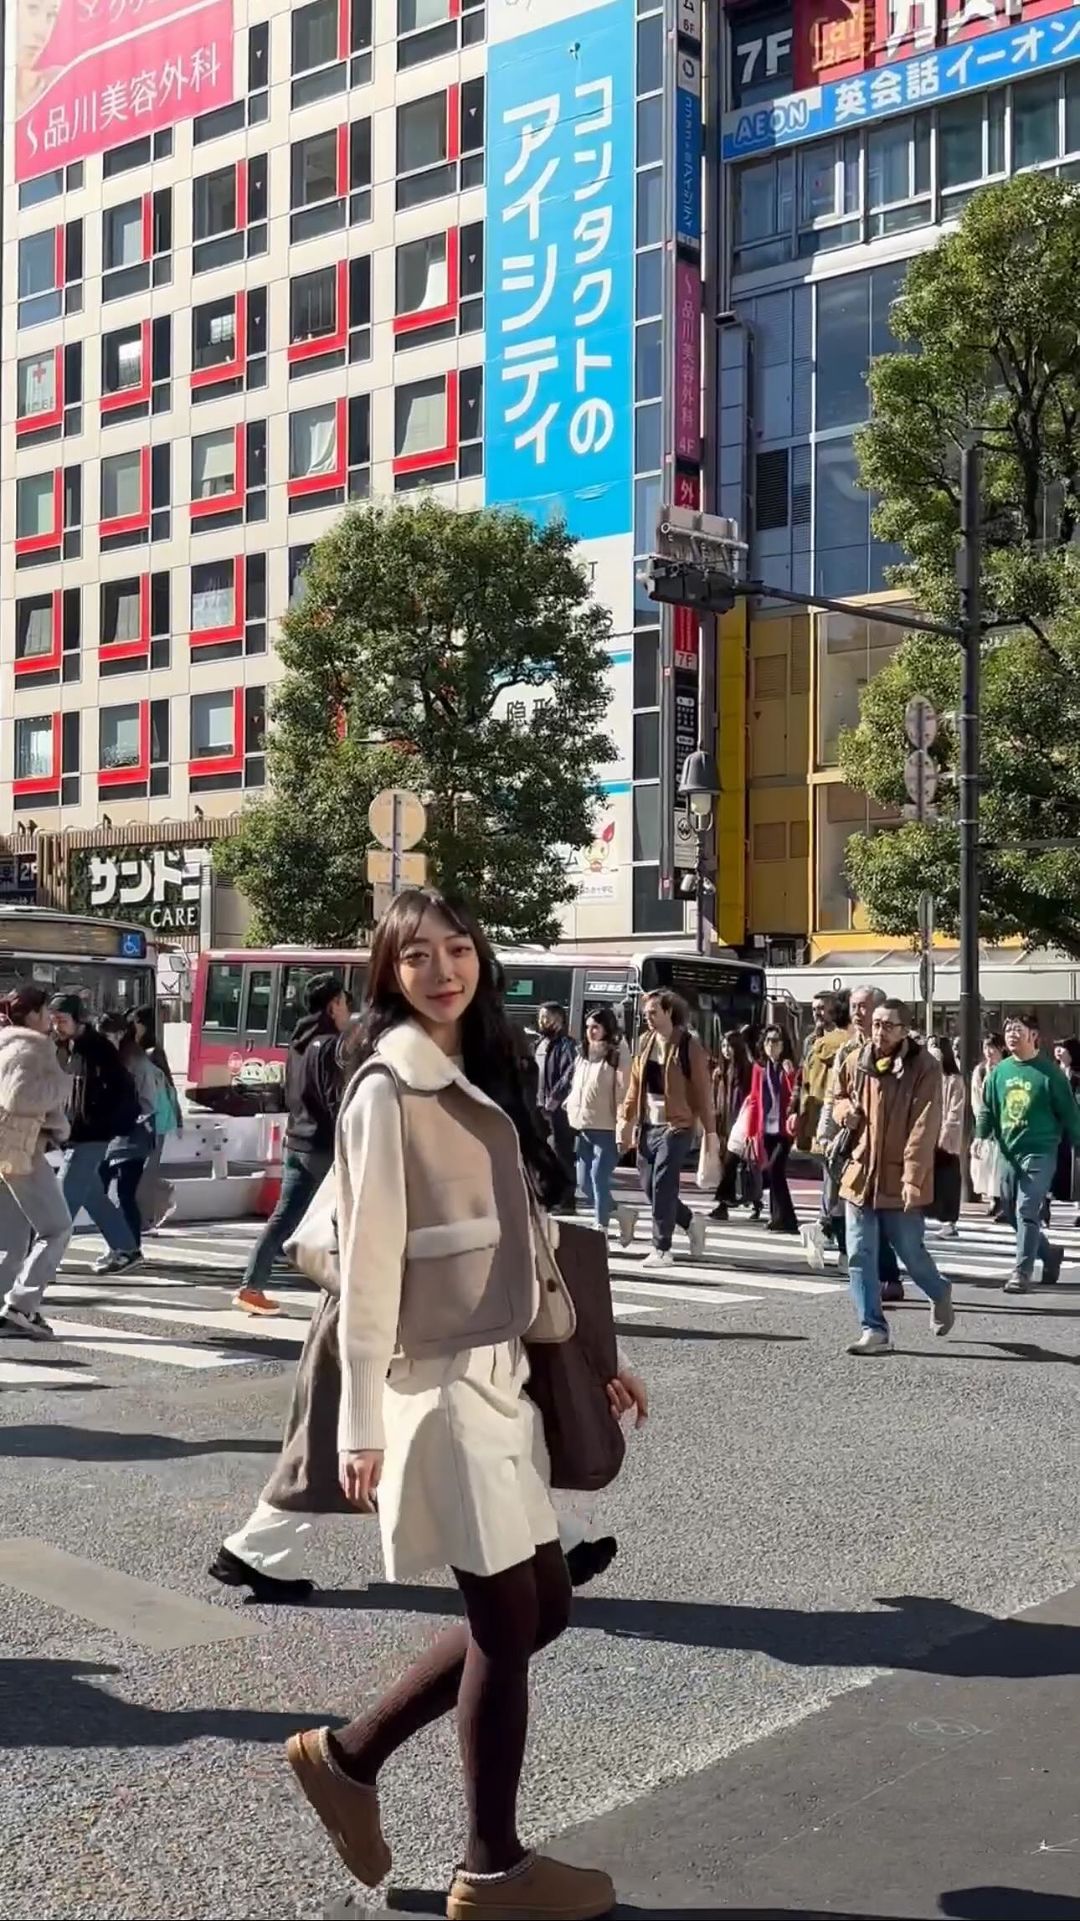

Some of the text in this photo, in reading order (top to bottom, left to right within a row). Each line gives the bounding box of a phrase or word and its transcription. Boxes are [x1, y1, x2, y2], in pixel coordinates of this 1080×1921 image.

[737, 28, 793, 84] 7F
[44, 42, 220, 151] 品川美容外科
[736, 98, 809, 144] AEON
[502, 93, 561, 464] アイシティ
[570, 74, 614, 454] コンタクトの
[679, 436, 695, 455] 4F
[678, 652, 693, 667] 7F
[150, 907, 197, 928] CARE
